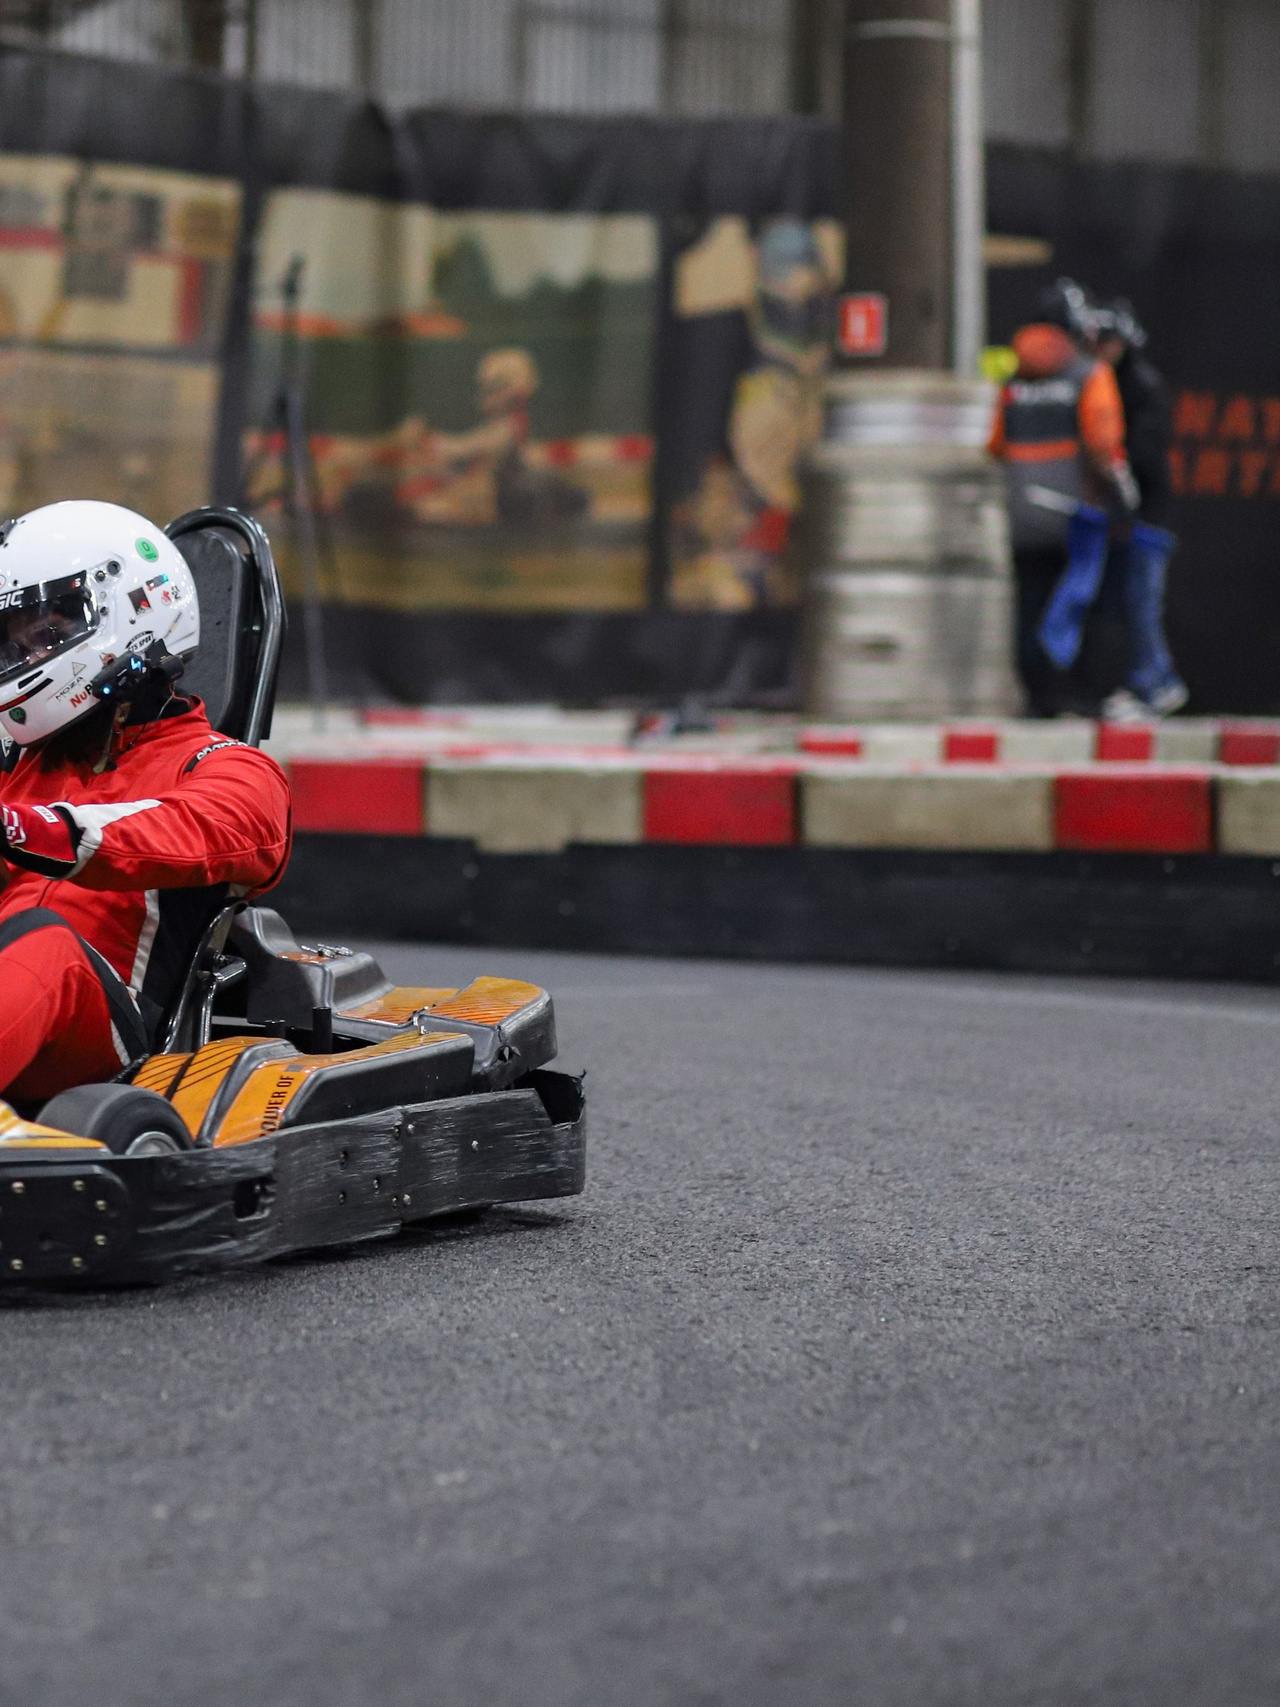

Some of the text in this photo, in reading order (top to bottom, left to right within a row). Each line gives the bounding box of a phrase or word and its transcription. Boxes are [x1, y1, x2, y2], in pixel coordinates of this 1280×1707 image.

[55, 676, 85, 702] MOZA
[259, 1074, 295, 1137] OWER OF
